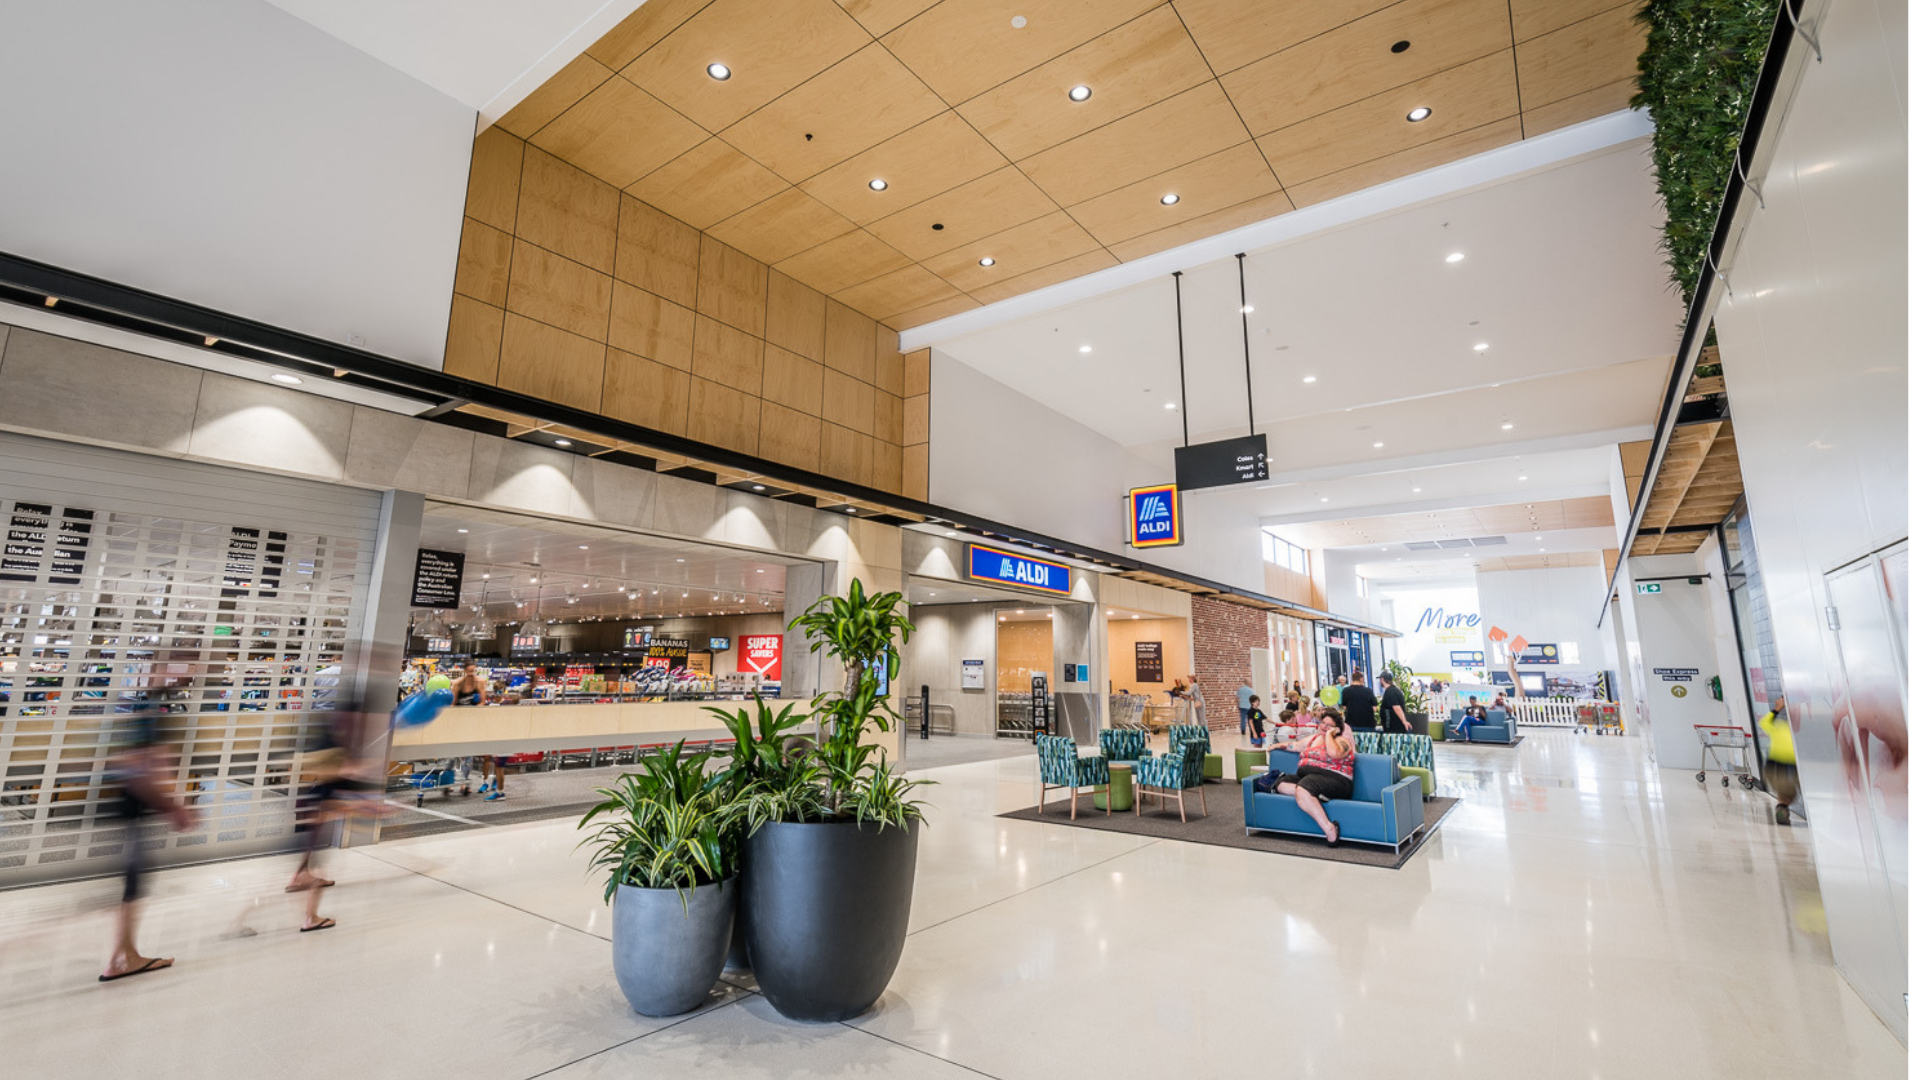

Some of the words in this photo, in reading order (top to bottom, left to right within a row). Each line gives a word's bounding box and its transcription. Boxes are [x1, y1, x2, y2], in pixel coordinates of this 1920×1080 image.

[1139, 521, 1170, 534] ALDI
[1015, 560, 1049, 586] ALDI
[1415, 607, 1481, 633] More
[650, 639, 688, 647] BANANAS
[747, 637, 779, 650] SUPER
[750, 649, 774, 658] SAVERS
